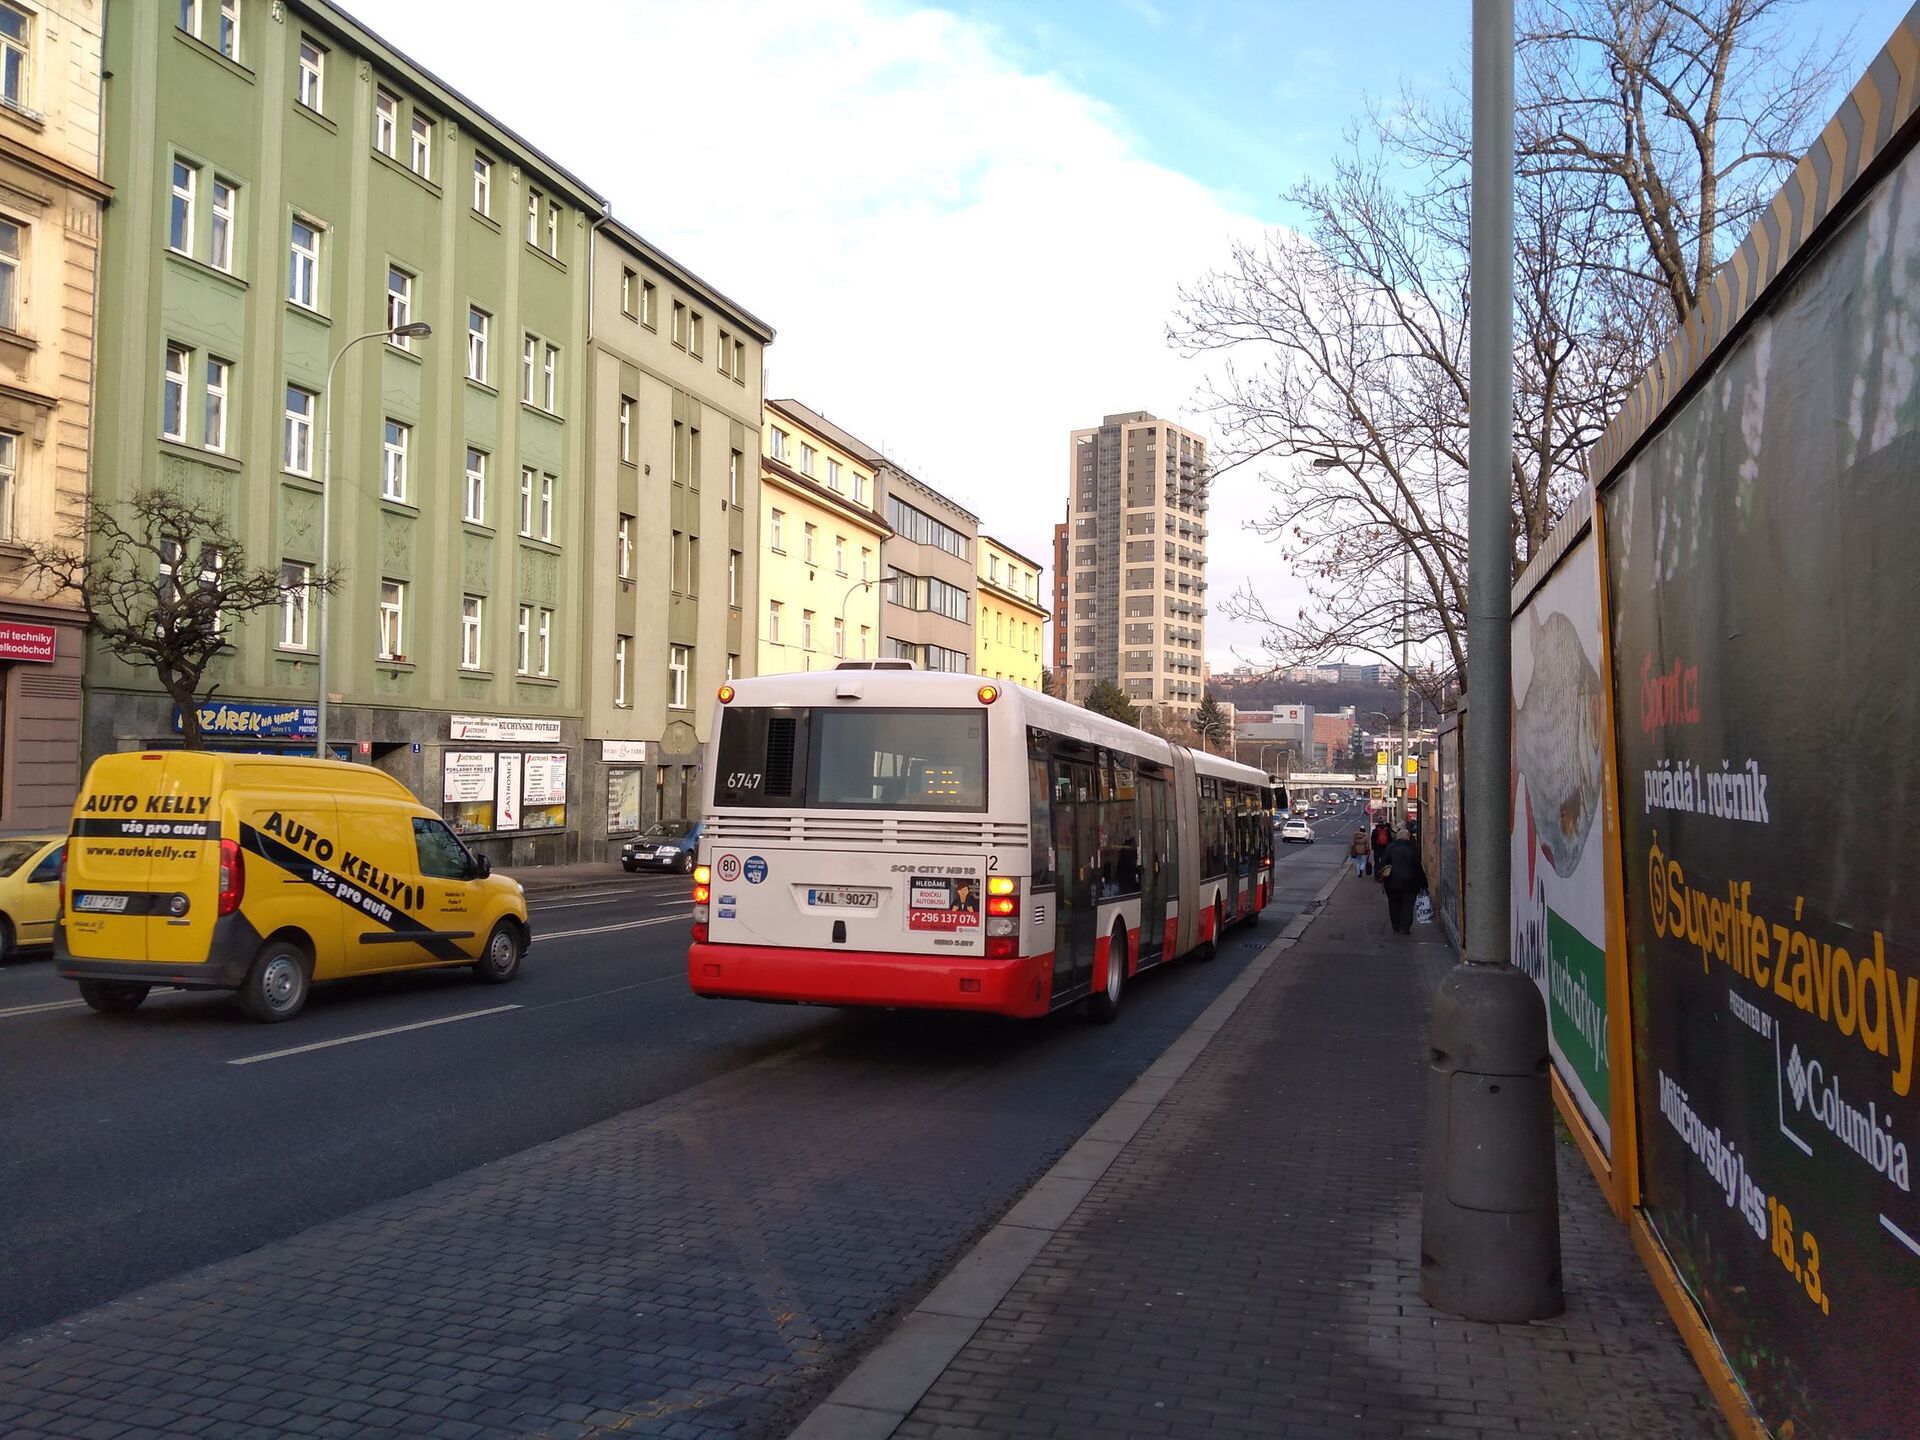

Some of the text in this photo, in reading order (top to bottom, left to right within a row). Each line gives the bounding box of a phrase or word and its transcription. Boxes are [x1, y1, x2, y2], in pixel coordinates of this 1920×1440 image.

[12, 631, 52, 645] techniky
[727, 772, 762, 790] 6747
[1644, 758, 1769, 824] pořádá 1. ročník
[83, 795, 212, 815] AUTO KELLY
[121, 820, 208, 837] vše pro auta
[86, 846, 197, 861] www.autokelly.cz
[263, 811, 406, 901] AUTO KELLY
[722, 859, 736, 872] 80
[917, 865, 944, 875] CITY
[988, 855, 998, 871] 2
[915, 880, 946, 888] HLEDÁME
[312, 868, 393, 922] vše pro auta
[816, 892, 873, 906] 4AL 9027
[921, 912, 977, 925] 296 137 074
[1666, 860, 1770, 989] Superlife
[1771, 895, 1920, 1097] závody
[1729, 988, 1772, 1040] PRESENTED BY
[1806, 1059, 1911, 1192] Columbia
[1738, 1152, 1767, 1241] les
